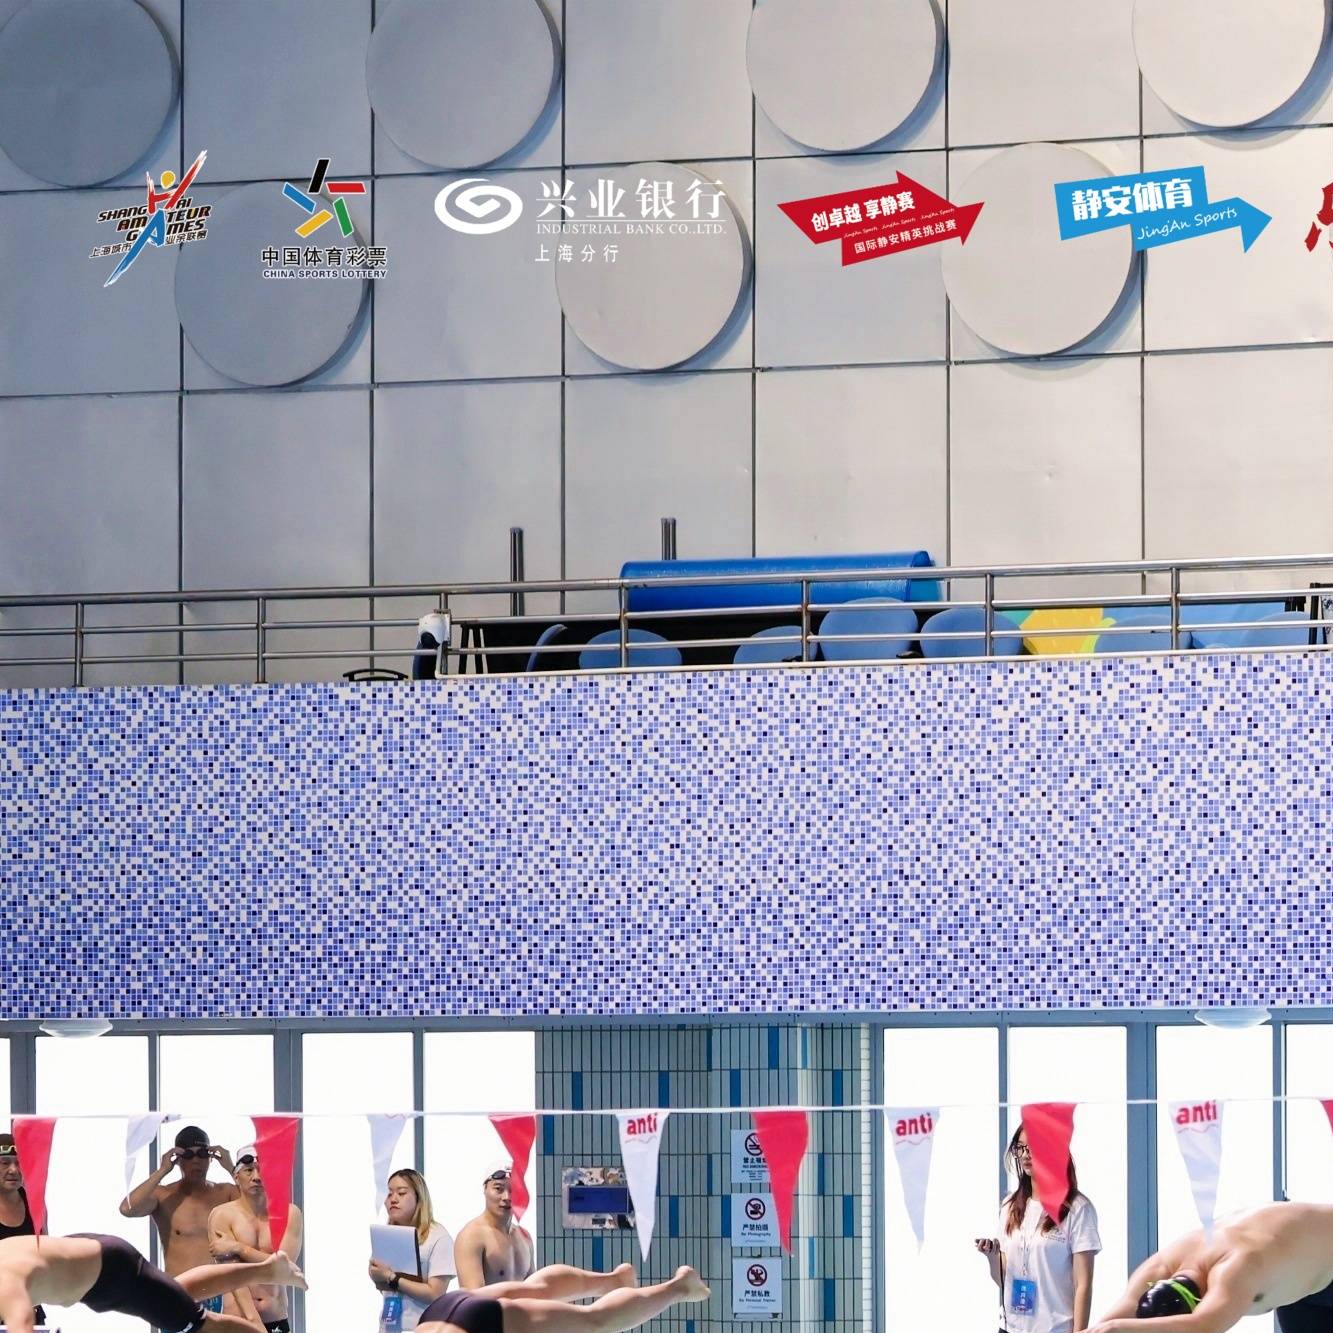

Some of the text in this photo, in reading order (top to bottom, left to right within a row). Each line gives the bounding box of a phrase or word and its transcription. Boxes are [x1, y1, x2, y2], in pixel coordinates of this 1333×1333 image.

[627, 1112, 658, 1137] anti
[895, 1112, 933, 1137] anti
[1176, 1100, 1218, 1125] anti
